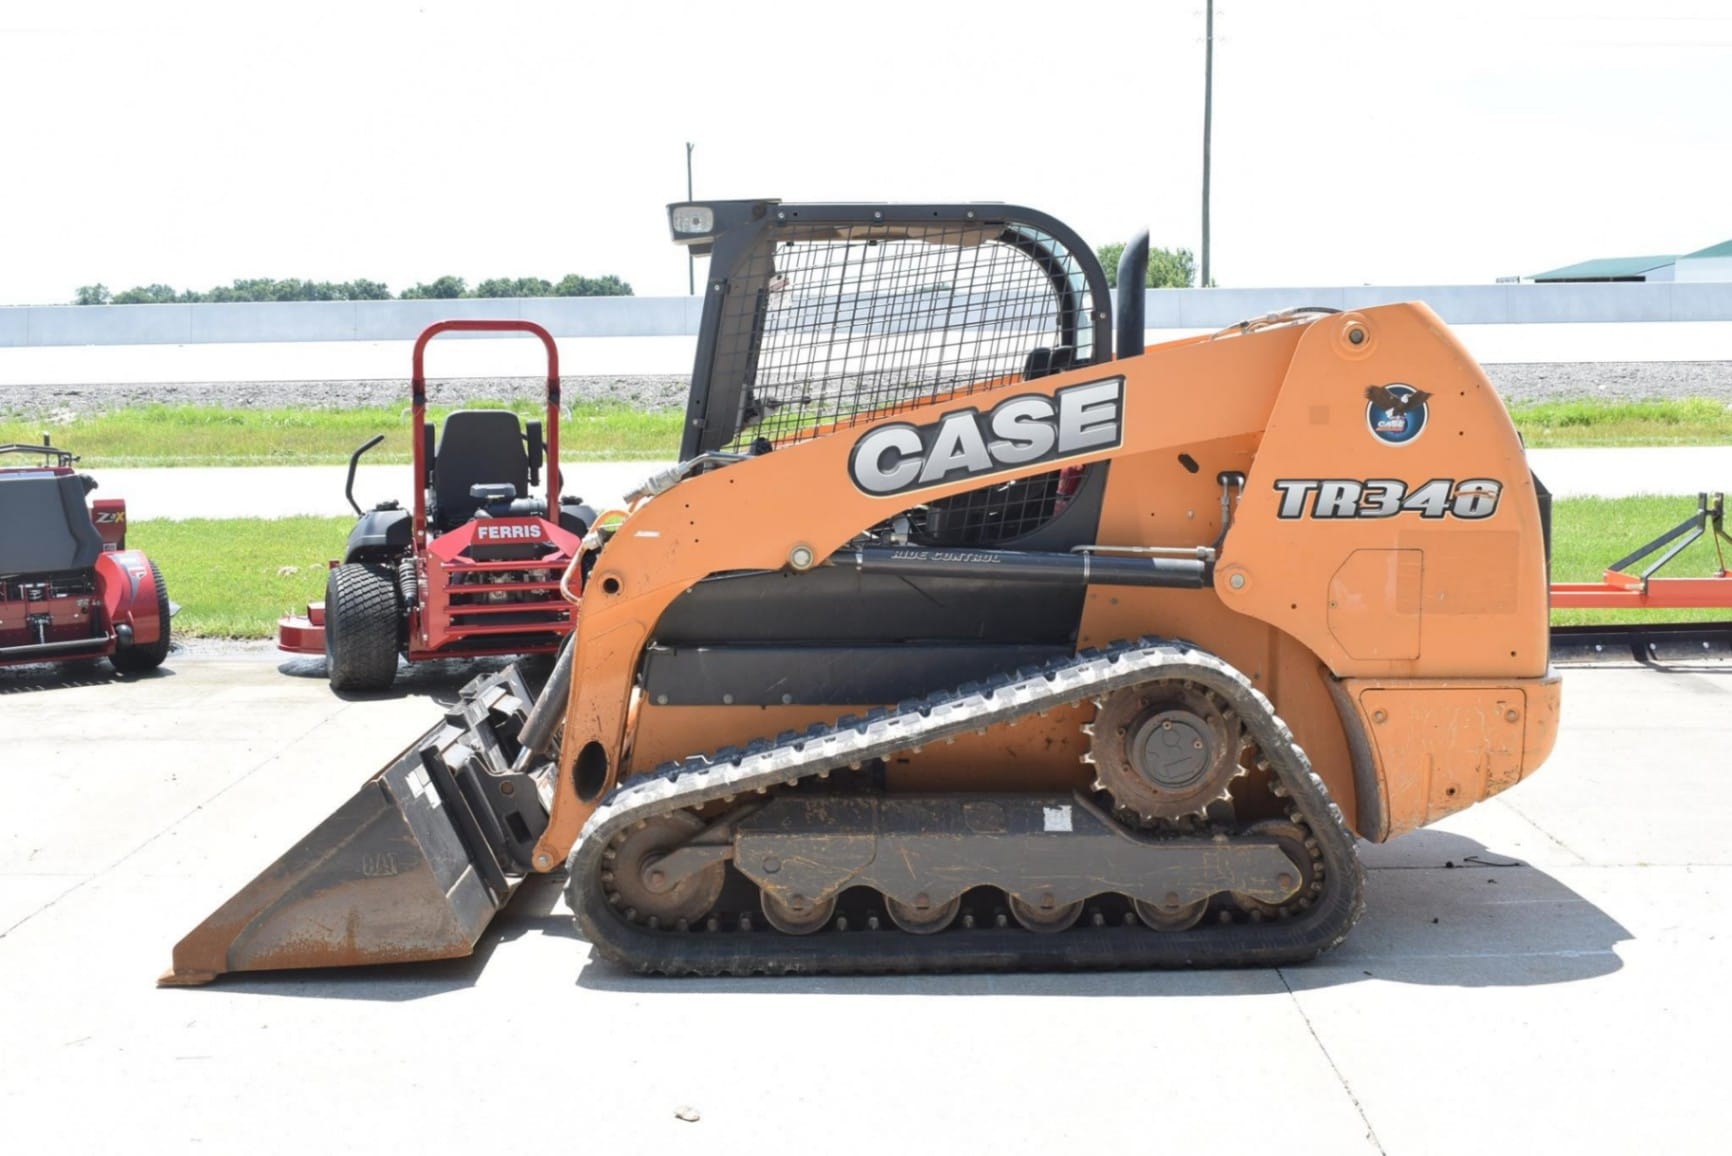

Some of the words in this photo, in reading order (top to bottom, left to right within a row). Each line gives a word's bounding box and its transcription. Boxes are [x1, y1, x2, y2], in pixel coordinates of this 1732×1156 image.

[850, 376, 1124, 495] CASE
[1274, 478, 1503, 519] TR340
[477, 525, 541, 539] FERRIS
[931, 552, 1001, 563] CONTROL
